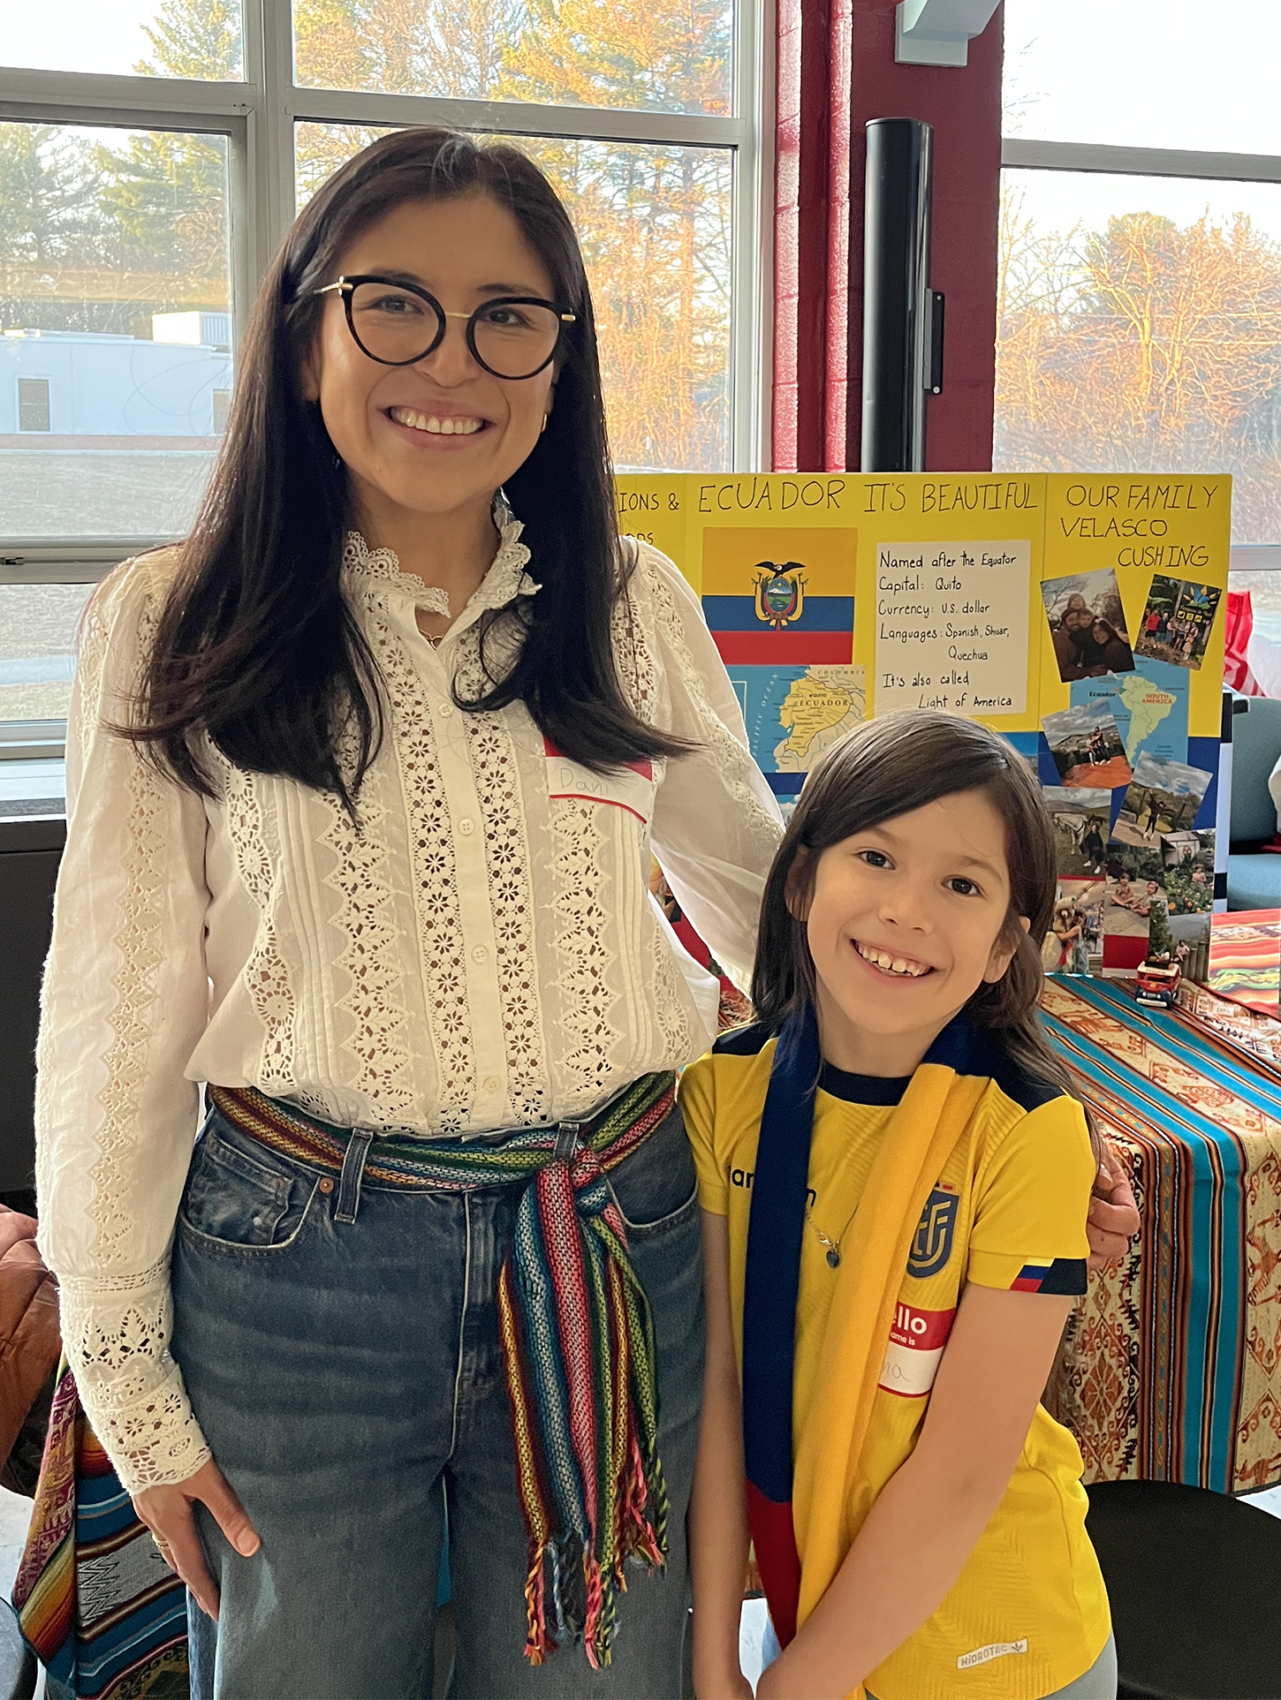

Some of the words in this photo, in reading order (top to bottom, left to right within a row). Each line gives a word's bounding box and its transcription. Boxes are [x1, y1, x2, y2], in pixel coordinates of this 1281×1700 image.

[618, 492, 660, 513] IONS
[668, 492, 680, 511] &
[698, 477, 846, 513] ECUADOR
[864, 482, 906, 512] IT'S
[921, 482, 1038, 513] BEAUTIFUL
[1066, 484, 1120, 509] OUR
[1127, 484, 1219, 510] FAMILY
[1060, 517, 1168, 538] VELASCO
[879, 550, 924, 568] Named
[931, 551, 957, 568] after
[960, 550, 975, 567] the
[980, 552, 1017, 568] Equator
[1117, 545, 1210, 567] CUSHING
[878, 574, 925, 596] Capital:
[935, 575, 962, 591] Quito
[878, 599, 934, 619] Currency:
[962, 599, 991, 614] dollar
[948, 645, 989, 661] Quechua
[882, 673, 906, 688] It's
[911, 672, 932, 687] also
[940, 669, 970, 686] called
[799, 699, 850, 707] ECUADOR
[918, 694, 949, 710] Light
[954, 692, 968, 707] of
[973, 696, 1013, 708] America
[893, 1305, 928, 1335] llo
[890, 1332, 907, 1345] ame
